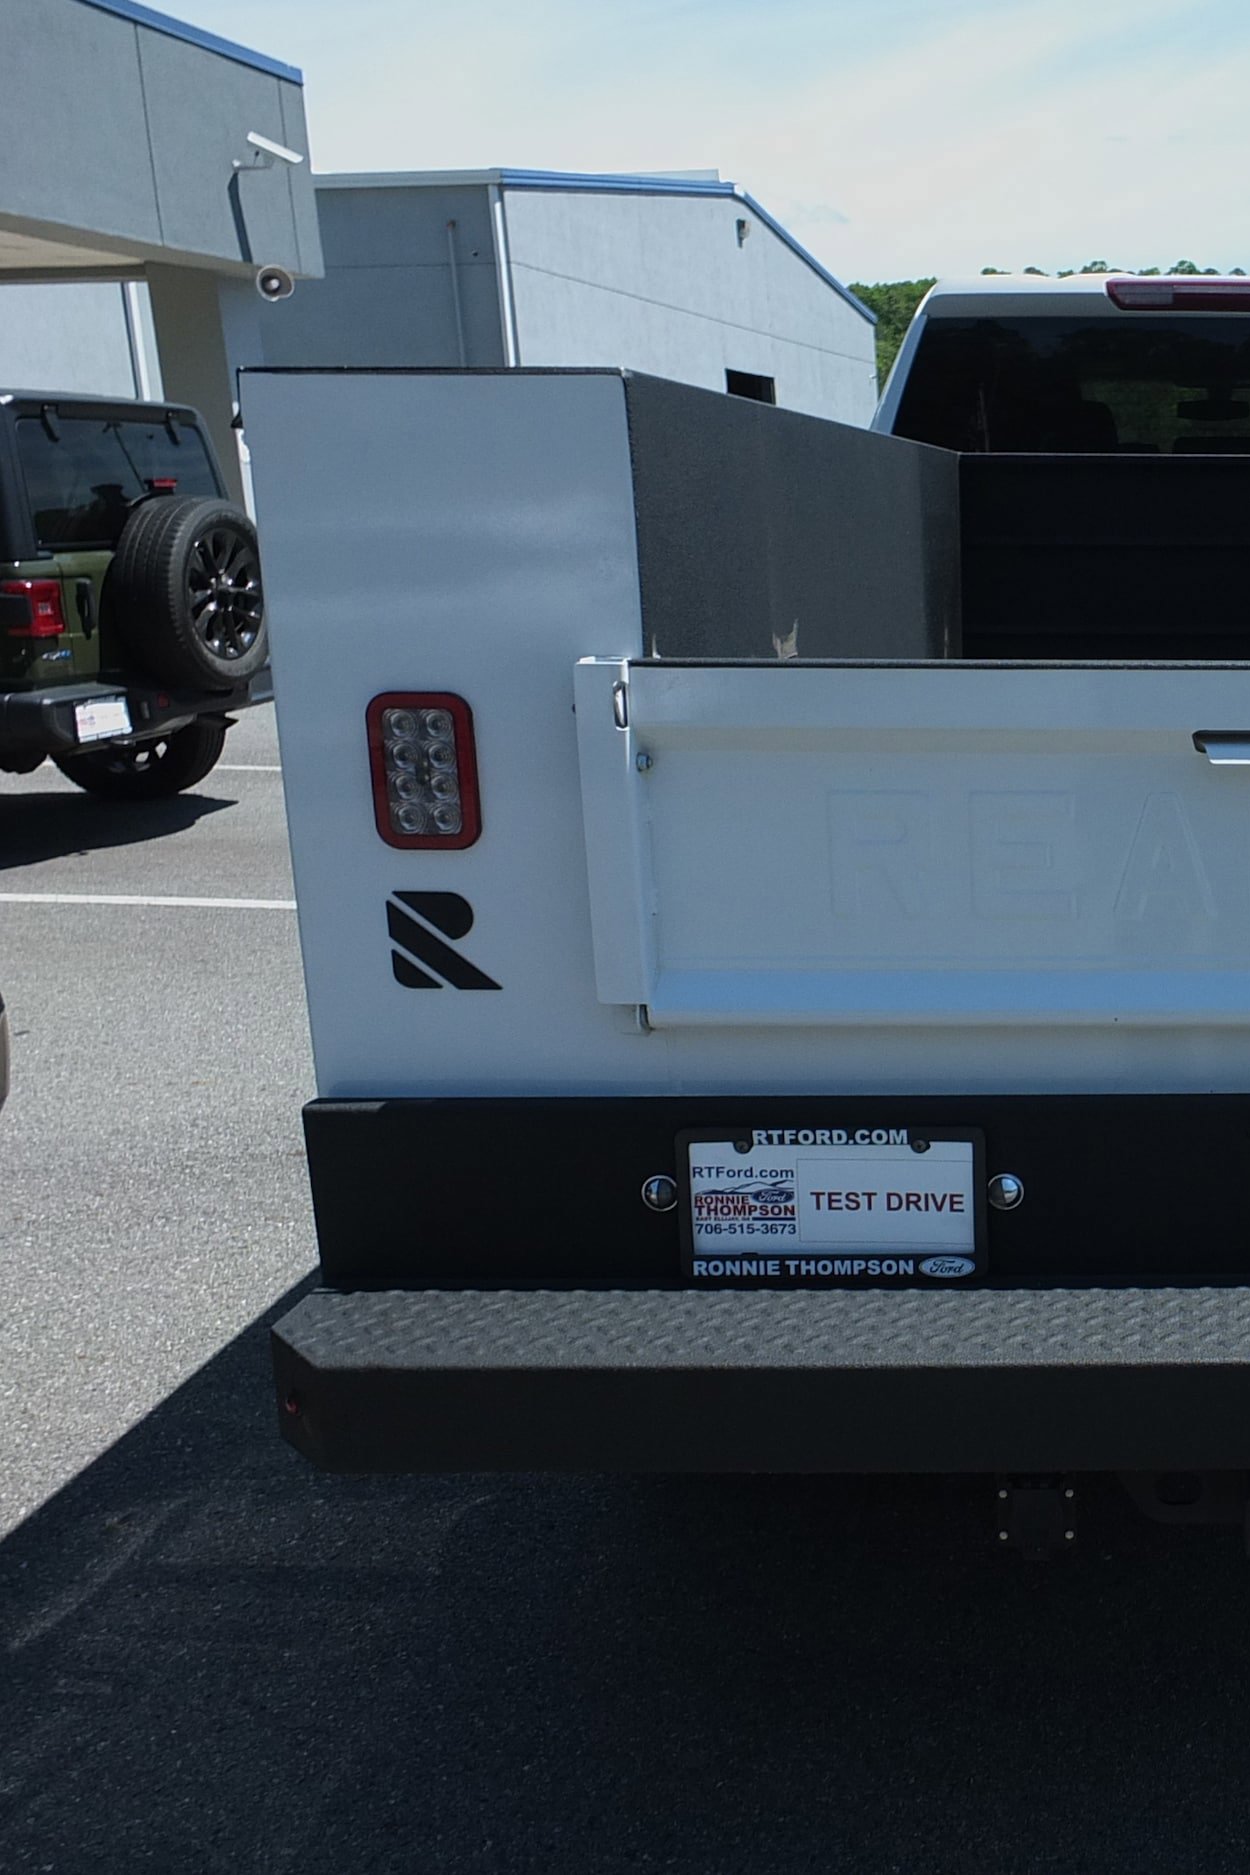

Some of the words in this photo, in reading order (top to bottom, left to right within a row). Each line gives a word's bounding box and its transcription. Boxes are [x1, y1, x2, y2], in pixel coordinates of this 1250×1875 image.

[752, 1128, 908, 1146] RTFORD.COM
[692, 1166, 794, 1179] RTFord.com
[694, 1195, 750, 1205] RONNIE
[810, 1191, 877, 1211] TEST
[886, 1193, 965, 1213] DRIVE
[694, 1204, 796, 1216] THOMPSON
[695, 1223, 796, 1235] 706-515-3673
[692, 1259, 781, 1277] RONNIE
[785, 1258, 914, 1276] THOMPSON
[929, 1259, 965, 1274] Ford
